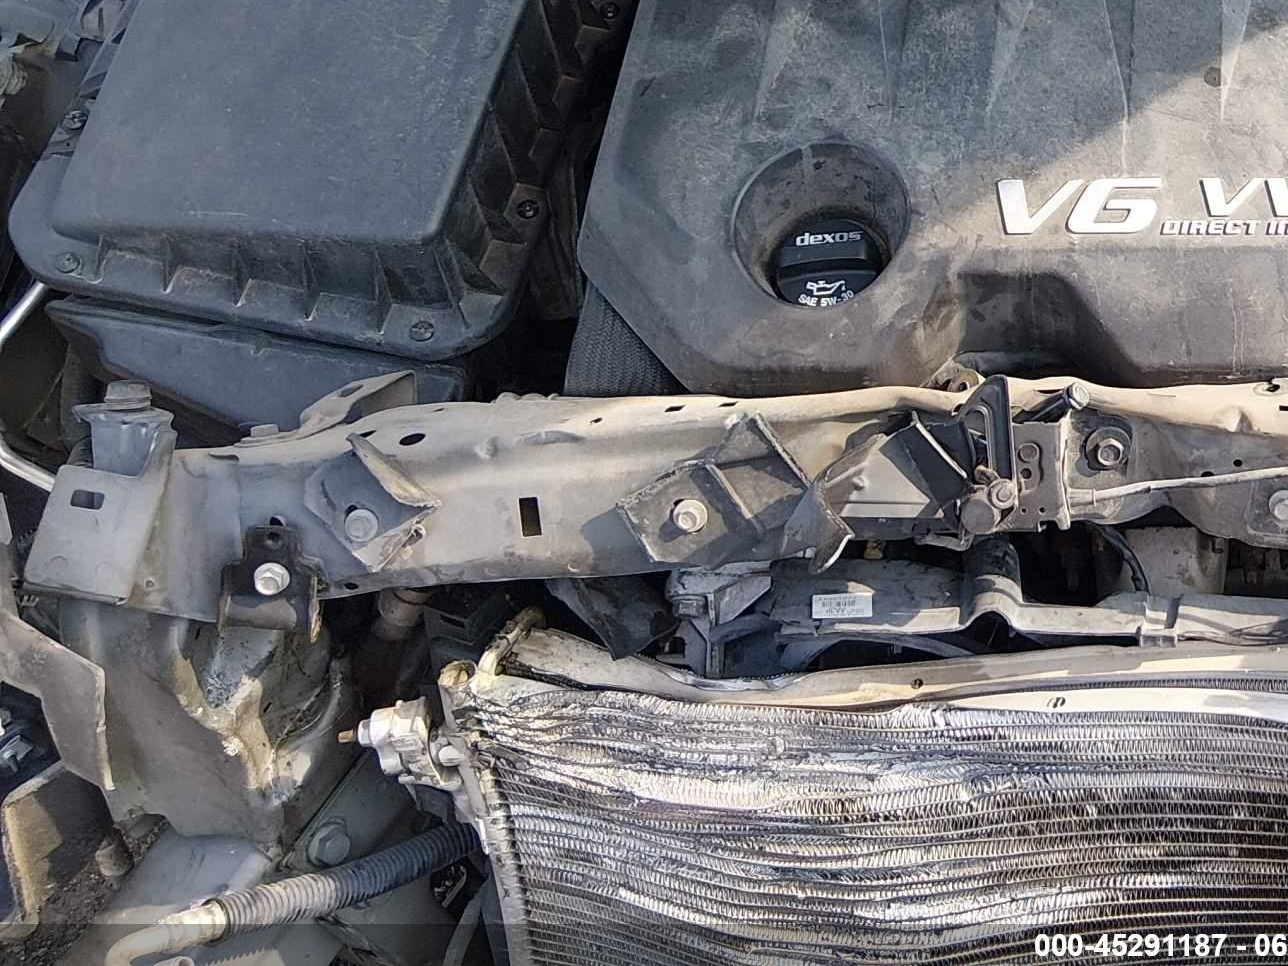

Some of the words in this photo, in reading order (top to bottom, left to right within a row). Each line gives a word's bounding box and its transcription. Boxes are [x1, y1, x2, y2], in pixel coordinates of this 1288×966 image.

[995, 176, 1163, 235] V6
[1159, 218, 1261, 236] DIRECT
[795, 230, 864, 246] dexos
[798, 294, 818, 307] SAE
[820, 290, 855, 307] 5W-30
